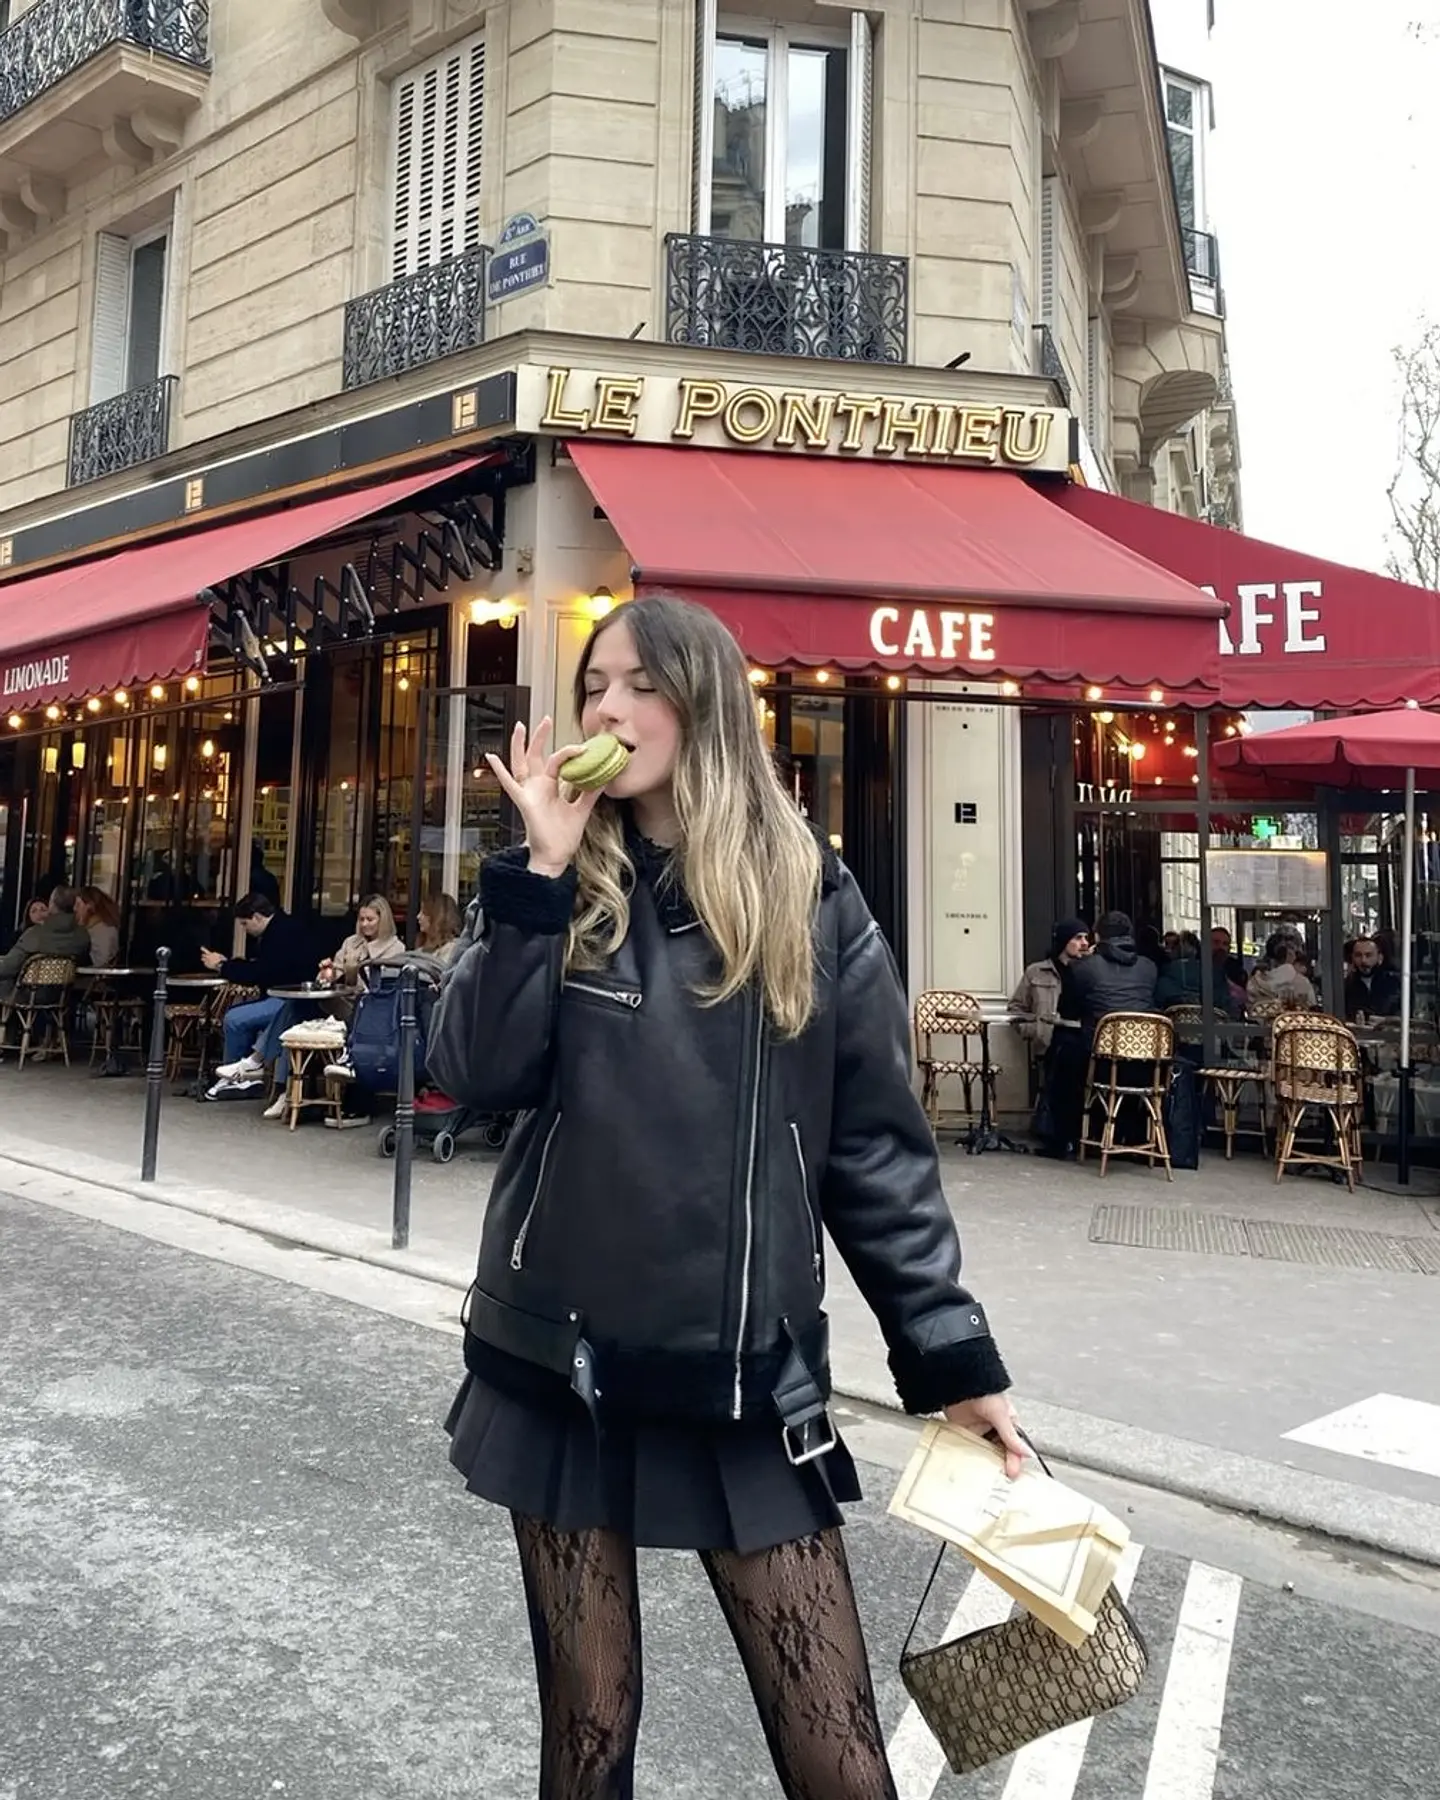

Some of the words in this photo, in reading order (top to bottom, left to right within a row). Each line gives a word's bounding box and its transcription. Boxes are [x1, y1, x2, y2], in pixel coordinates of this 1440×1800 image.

[509, 252, 527, 270] RUE
[539, 366, 645, 438] LE
[671, 377, 1055, 465] PONTHIEU
[869, 606, 996, 661] CAFE
[3, 655, 70, 695] LIMONADE
